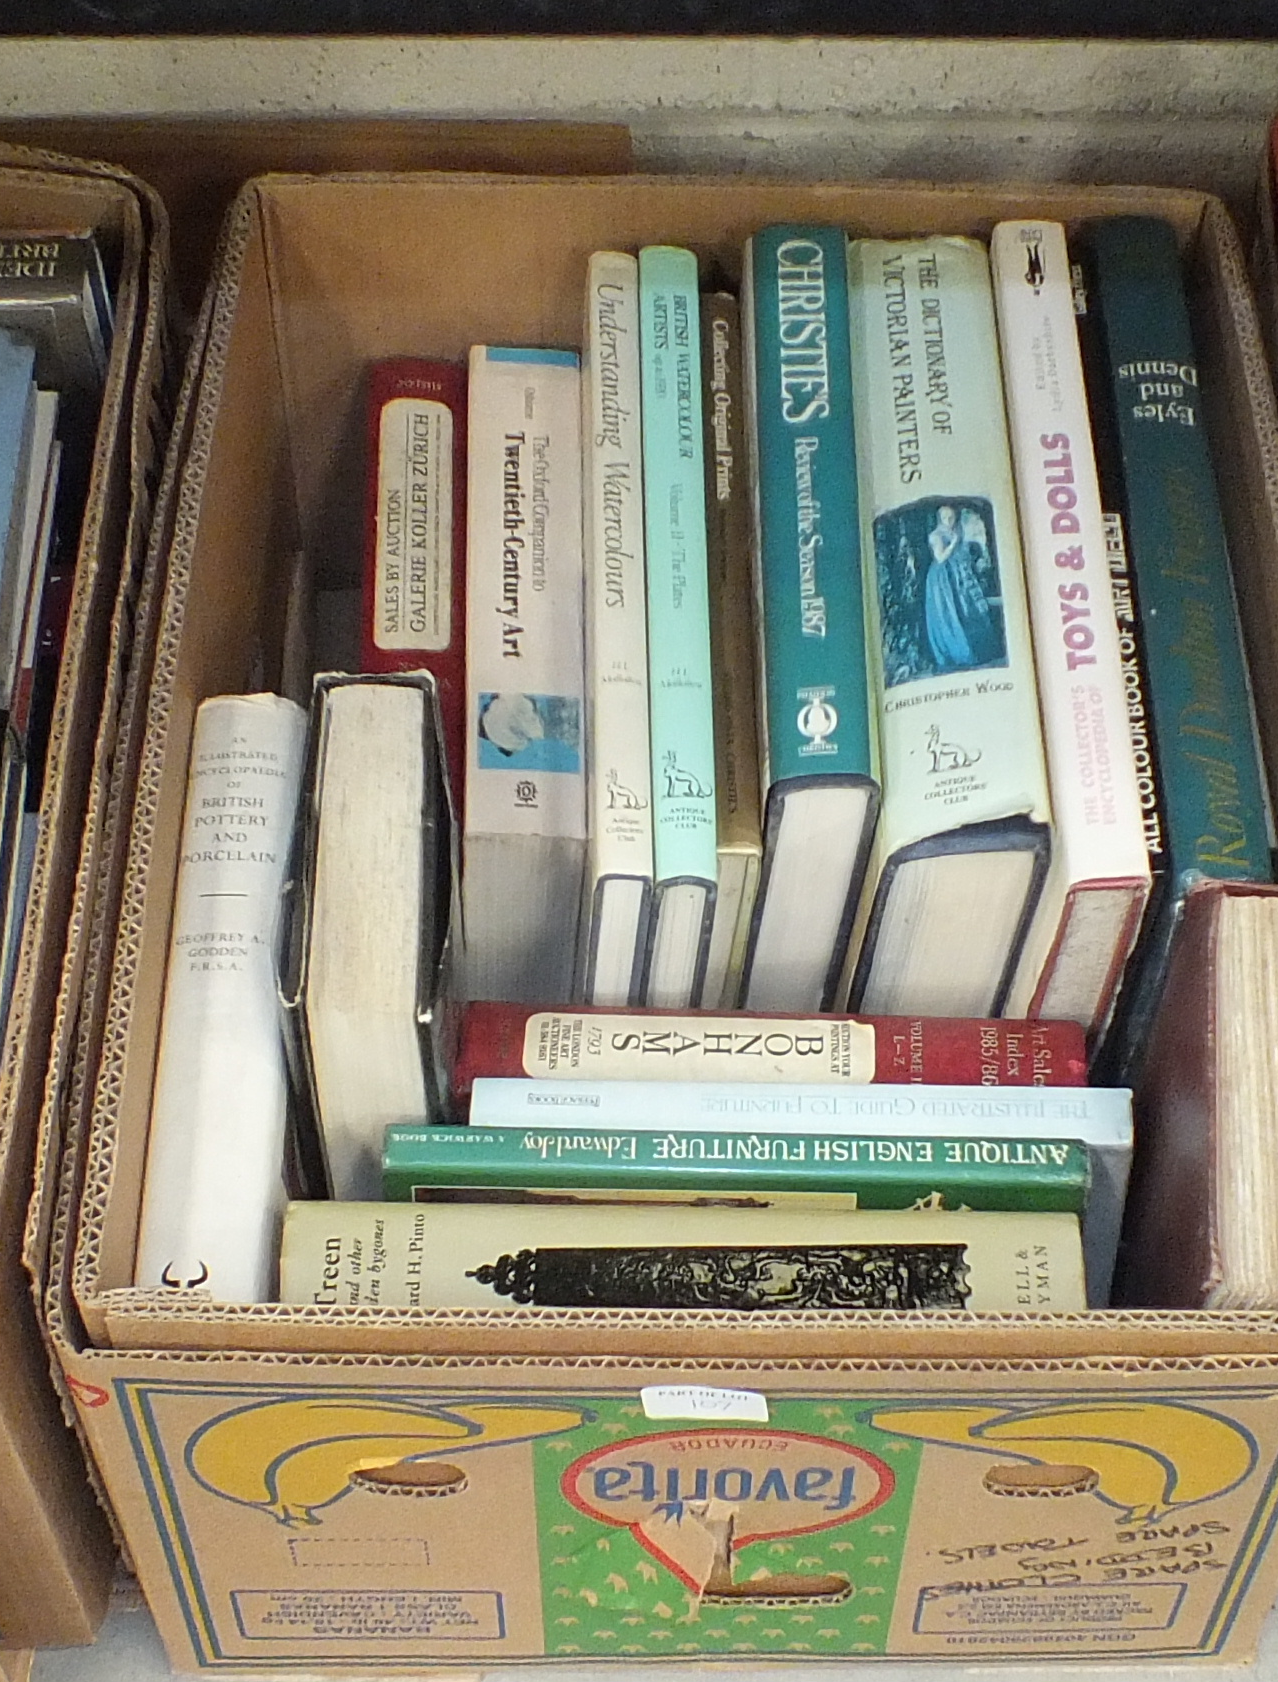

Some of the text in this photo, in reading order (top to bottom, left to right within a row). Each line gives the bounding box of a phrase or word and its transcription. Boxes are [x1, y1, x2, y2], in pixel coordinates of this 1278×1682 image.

[651, 294, 670, 351] ARTISTS
[918, 252, 952, 436] THE DICTIONARY OF
[672, 294, 695, 460] BRITISH WATERCOLOUR
[882, 253, 922, 485] VICTORIAN PAINTERS
[1117, 360, 1199, 387] Dennis
[1139, 381, 1185, 401] and
[710, 319, 733, 500] Collecting Original Prints
[1133, 404, 1196, 427] Eyles
[596, 283, 636, 609] Understanding Watercolours
[405, 412, 430, 634] GALERIE KOLLER ZÜRICH
[495, 431, 526, 659] Twentieth-Century Art
[527, 460, 550, 591] Oxford Companion to
[793, 436, 827, 638] Review Season 1987
[383, 487, 402, 634] SALES BY AUCTION
[1039, 433, 1099, 671] TOYS & DOLLS
[884, 679, 1015, 714] CHRISTOPHER WOOD
[1085, 706, 1122, 825] ENCYCLOPEDIA
[1116, 625, 1165, 855] ALL COLOUR BOOK OF
[194, 814, 270, 828] POTTERY
[202, 798, 265, 809] BRITISH
[1082, 796, 1101, 826] THE
[1179, 749, 1253, 873] Royal
[212, 832, 249, 844] AND
[908, 1019, 923, 1072] VOLUME
[978, 1027, 1000, 1087] 1985/86
[1006, 1032, 1022, 1077] Index
[1033, 1021, 1053, 1047] Art
[700, 1096, 1091, 1121] THE ILLUSTRATED GUIDE TO FURNITURE
[519, 1131, 1071, 1166] ANTIQUE ENGLISH FURNITURE Edward Joy
[348, 1238, 363, 1276] other
[369, 1218, 390, 1273] bygones
[407, 1213, 426, 1280] H. Pinto
[671, 1436, 789, 1454] ECUADOR
[592, 1459, 857, 1512] favorita
[1114, 1520, 1231, 1544] SPARE
